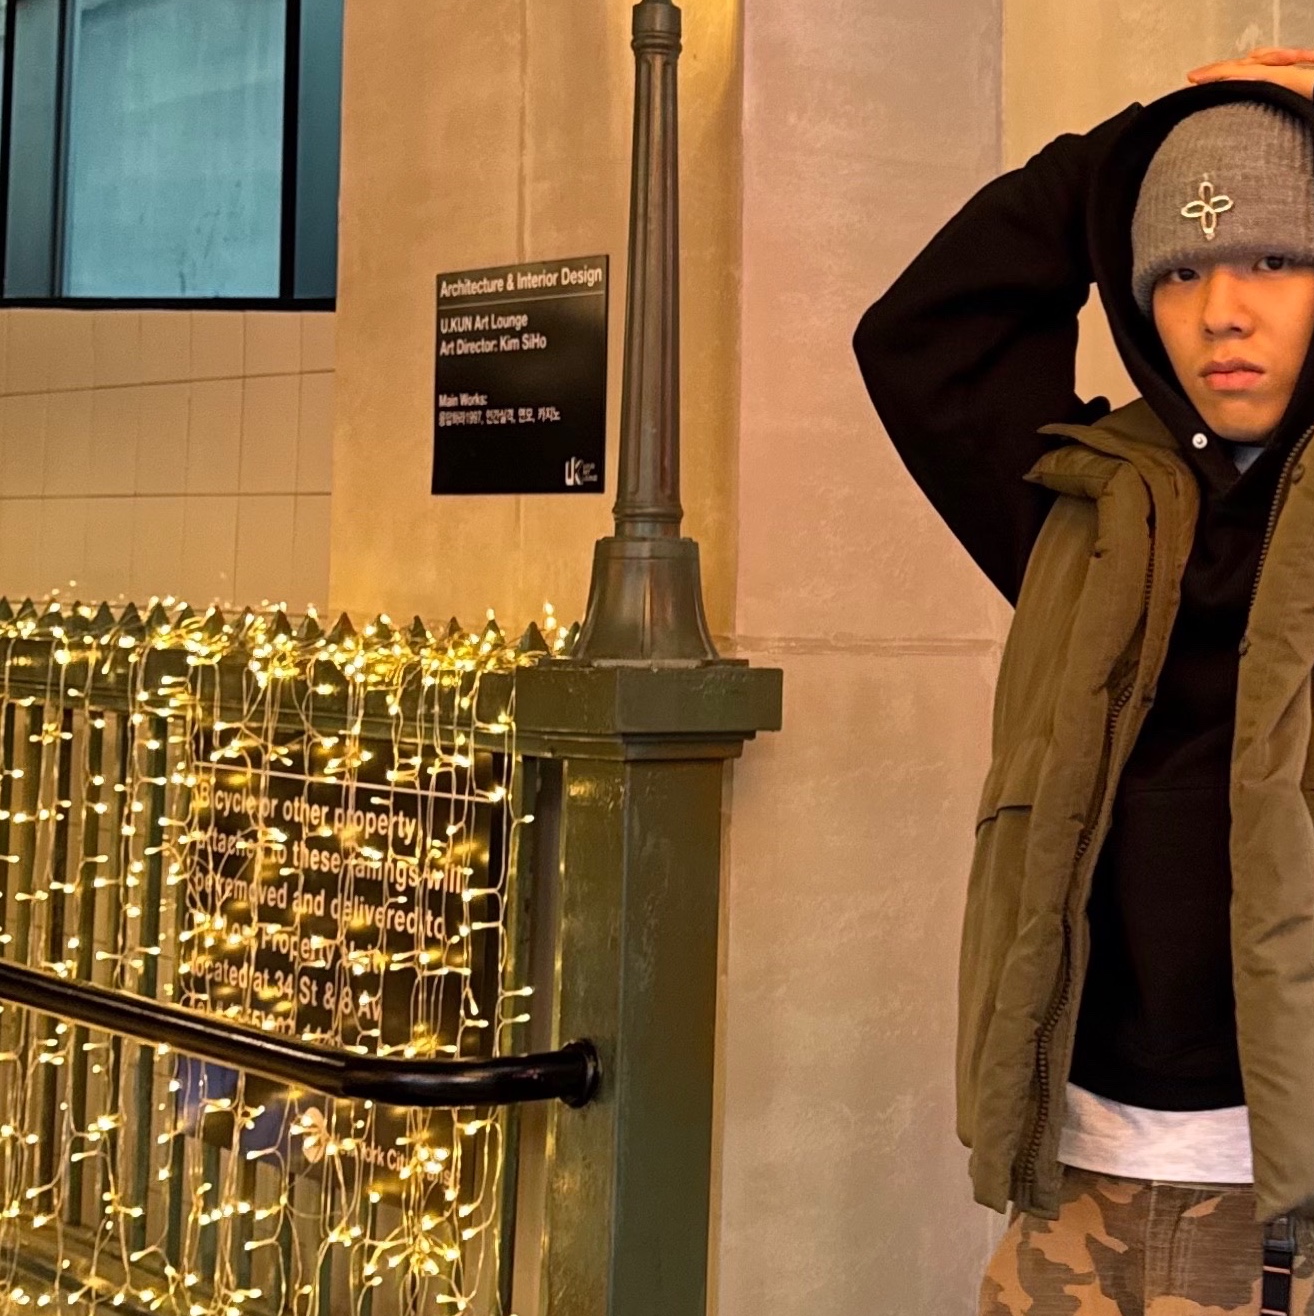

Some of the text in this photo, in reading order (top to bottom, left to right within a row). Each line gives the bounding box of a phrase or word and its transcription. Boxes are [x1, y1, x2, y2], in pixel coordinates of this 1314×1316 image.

[440, 265, 602, 298] Architecture & Interior Design
[474, 314, 489, 331] Art
[491, 313, 528, 332] Lounge
[440, 340, 455, 356] Art
[456, 337, 498, 355] Director:
[500, 334, 520, 351] Kim
[439, 393, 459, 407] Main
[200, 781, 257, 817] Bcycle
[283, 796, 329, 827] other
[334, 807, 416, 845] property
[293, 840, 341, 874] these
[347, 853, 419, 891] ailings
[292, 888, 326, 917] and
[330, 892, 419, 935] delivered
[274, 970, 293, 998] 34
[300, 974, 318, 1007] St
[323, 981, 335, 1010] &
[387, 1147, 411, 1176] Cit
